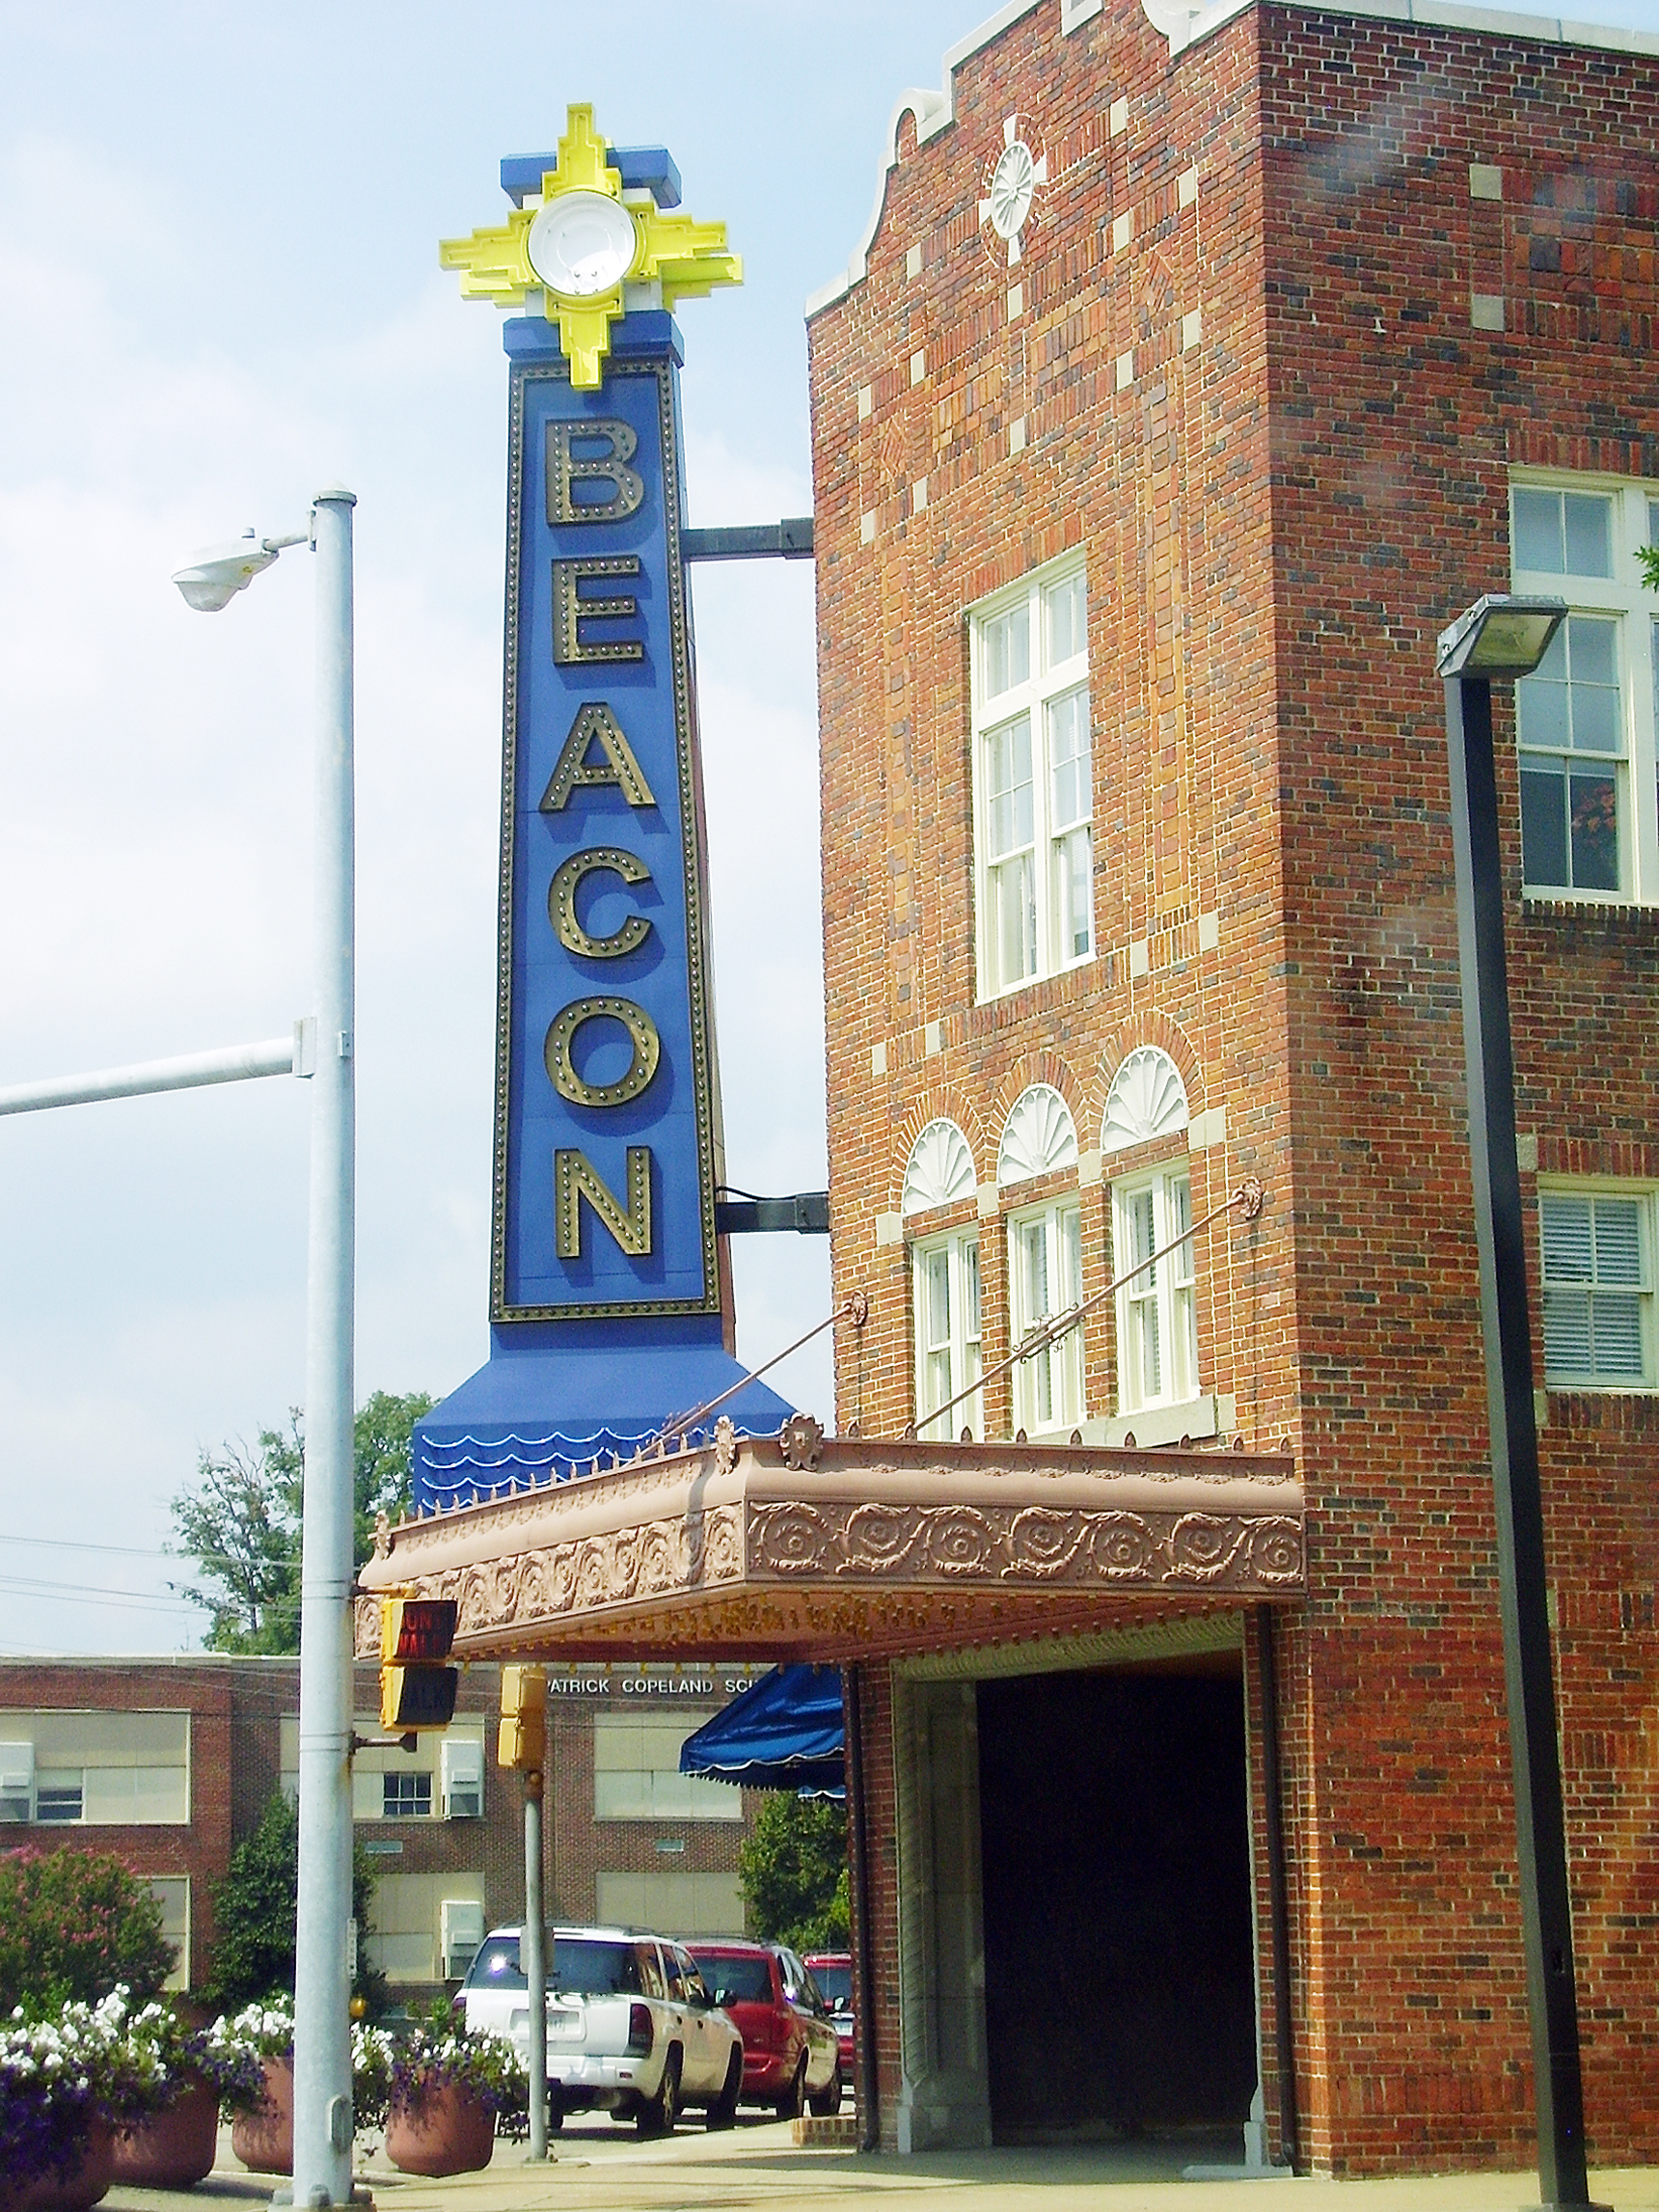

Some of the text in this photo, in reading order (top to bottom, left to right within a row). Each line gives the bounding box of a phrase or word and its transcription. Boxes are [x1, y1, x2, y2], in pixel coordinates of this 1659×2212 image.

[539, 419, 660, 1258] BEACON
[547, 1679, 611, 1693] ATRICK
[621, 1679, 713, 1694] COPELAND
